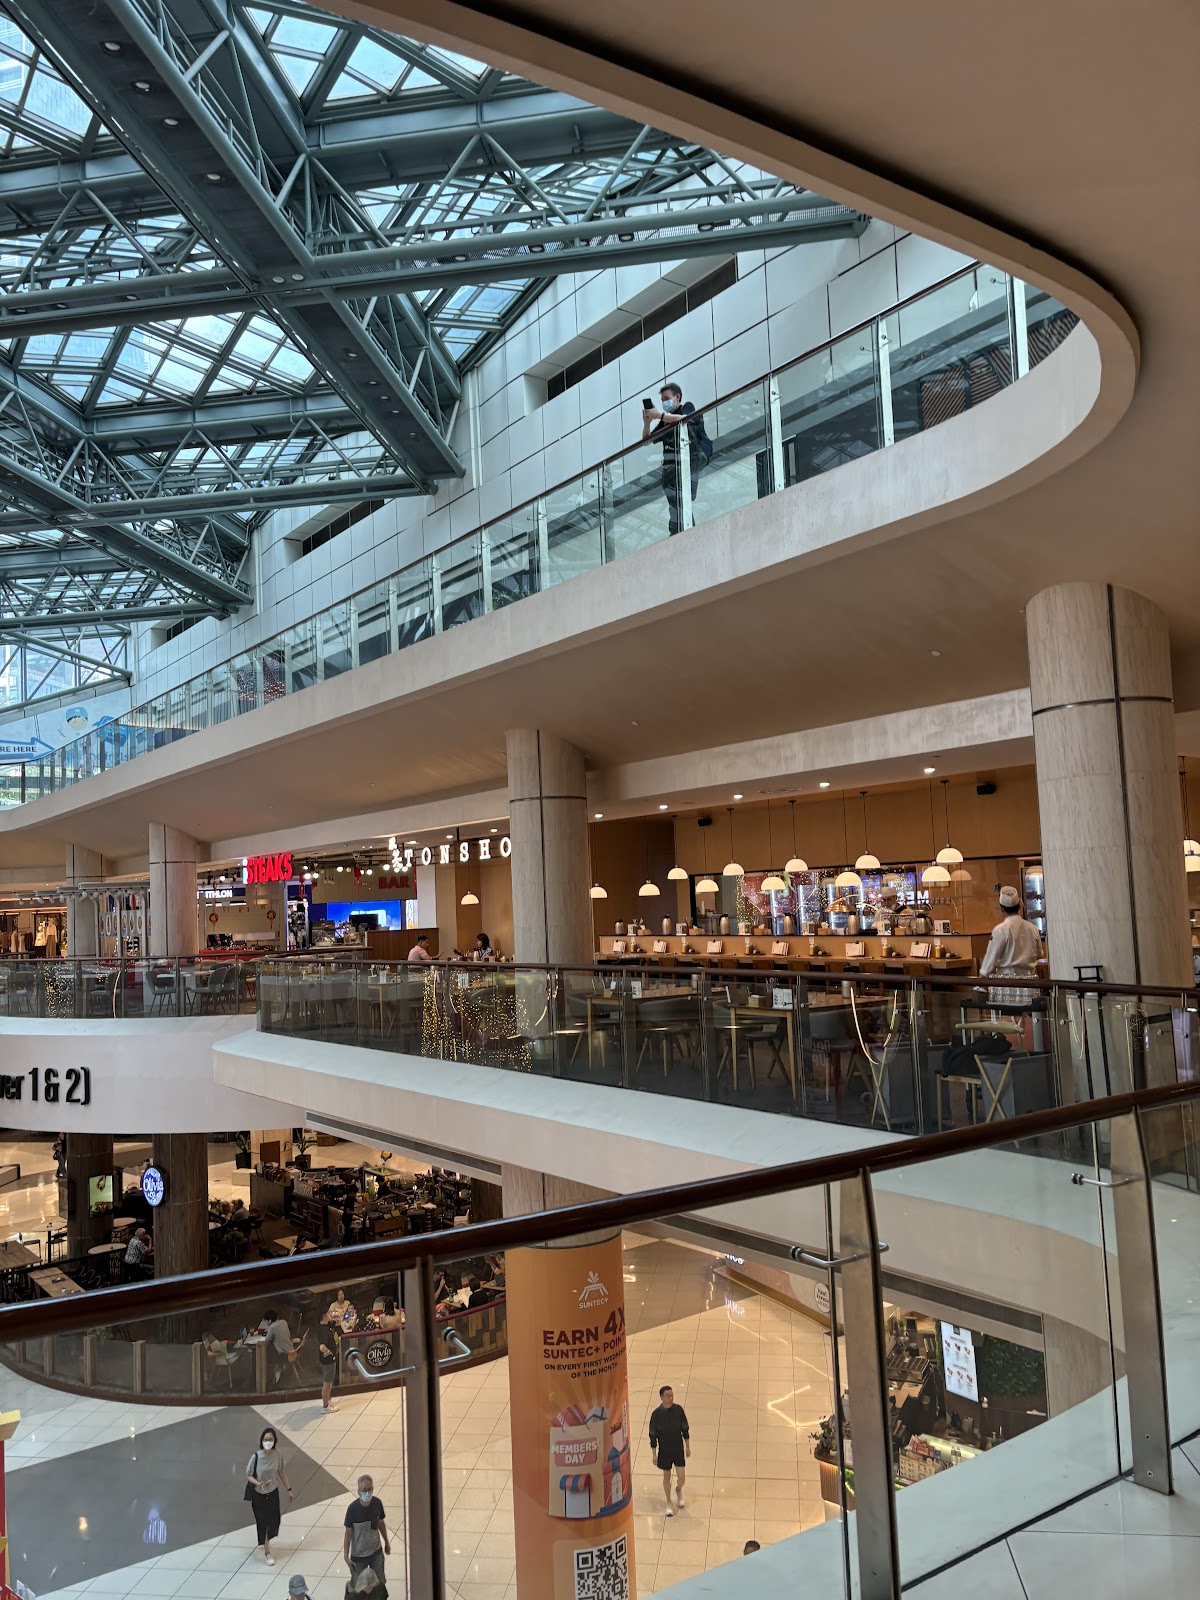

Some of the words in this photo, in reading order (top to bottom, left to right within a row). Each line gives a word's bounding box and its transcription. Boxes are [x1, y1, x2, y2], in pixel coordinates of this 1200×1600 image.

[376, 876, 411, 890] BAR
[28, 1067, 39, 1102] 1
[44, 1067, 60, 1103] &
[65, 1066, 91, 1106] 2)
[543, 1329, 599, 1346] EARN
[543, 1346, 600, 1360] SUNTEC+
[544, 1363, 556, 1371] ON
[557, 1362, 582, 1371] EVERY
[584, 1358, 603, 1369] FIRST
[570, 1372, 582, 1380] OF
[583, 1368, 598, 1378] THE
[564, 1453, 586, 1464] DAY
